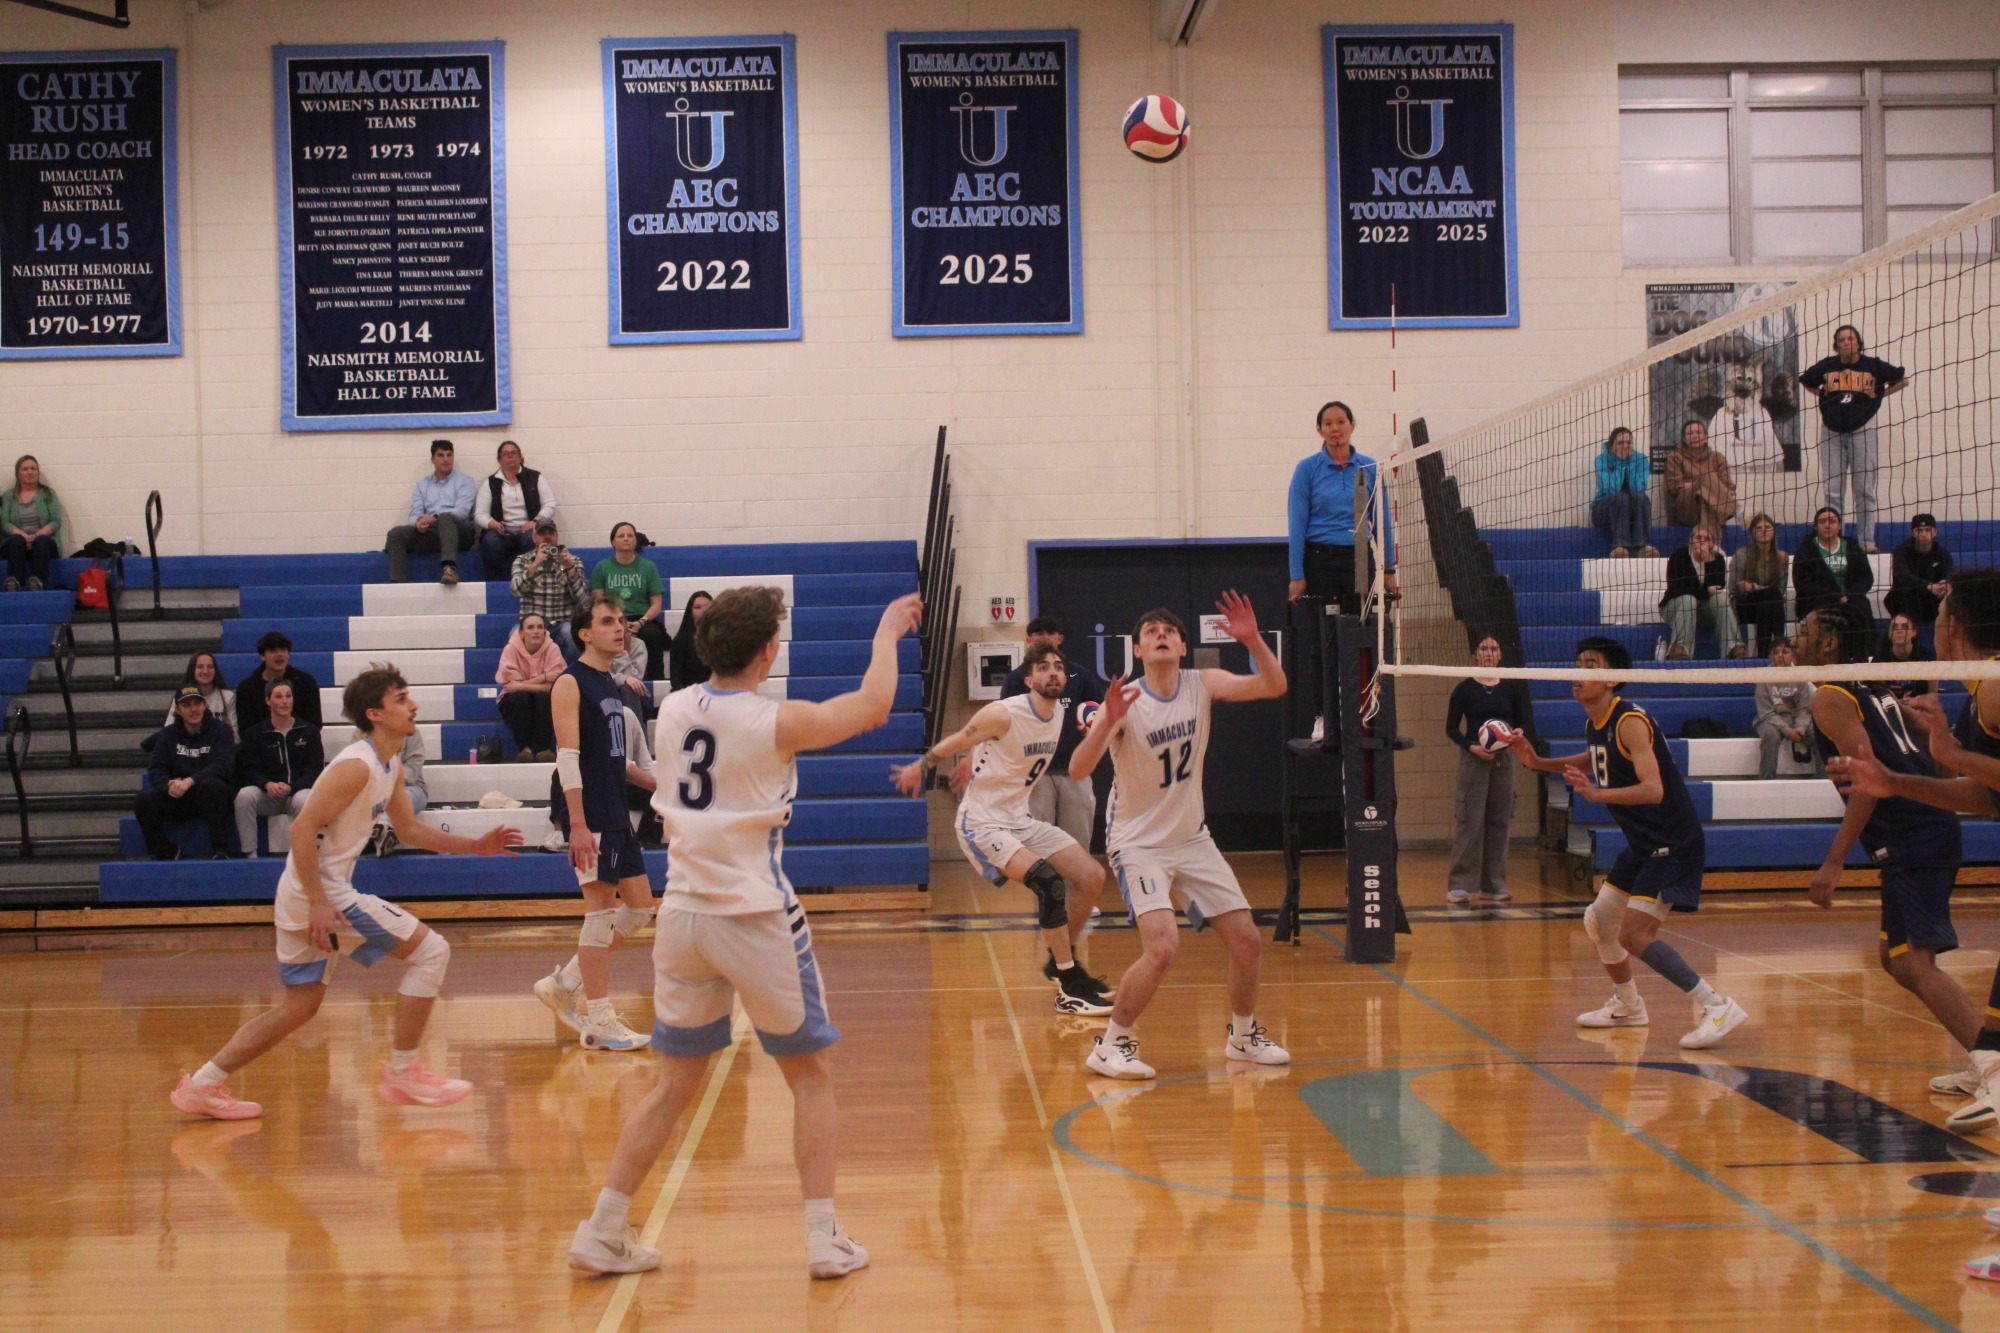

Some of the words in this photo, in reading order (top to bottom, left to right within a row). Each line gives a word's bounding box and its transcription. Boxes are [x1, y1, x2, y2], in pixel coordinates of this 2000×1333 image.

[907, 52, 1060, 73] IMMACULATA
[1343, 45, 1495, 66] IMMACULATA
[622, 56, 776, 79] IMMACULATA
[1346, 69, 1408, 81] WOMEN'S
[1411, 67, 1493, 80] BASKETBALL
[17, 70, 141, 101] CATHY
[297, 67, 482, 94] IMMACULATA
[624, 81, 687, 93] WOMEN'S
[690, 79, 774, 93] BASKETBALL
[910, 75, 971, 88] WOMEN'S
[975, 74, 1058, 87] BASKETBALL
[301, 99, 374, 112] WOMEN'S
[379, 96, 480, 111] BASKETBALL
[31, 104, 128, 133] RUSH
[365, 116, 416, 129] TEAMS
[9, 143, 70, 161] HEAD
[76, 141, 153, 159] COACH
[303, 145, 348, 160] 1972
[369, 144, 415, 159] 1973
[436, 142, 481, 158] 1974
[40, 169, 124, 183] IMMACULATA
[1372, 166, 1473, 196] NCAA
[52, 184, 113, 198] WOMEN'S
[666, 178, 738, 208] AEC
[950, 172, 1021, 202] AEC
[42, 199, 123, 213] BASKETBALL
[911, 205, 1061, 228] CHAMPIONS
[1349, 200, 1496, 221] TOURNAMENT
[627, 211, 779, 235] CHAMPIONS
[1359, 226, 1409, 243] 2022
[1437, 224, 1488, 241] 2025
[34, 222, 130, 251] 149-15
[12, 264, 79, 277] NAISMITH
[82, 262, 154, 276] MEMORIAL
[657, 260, 751, 291] 2022
[939, 254, 1033, 285] 2025
[42, 278, 125, 292] BASKETBALL
[36, 294, 72, 307] HALL
[75, 293, 93, 306] OF
[96, 292, 132, 305] FAME
[26, 315, 142, 336] 1970-1977
[360, 321, 432, 344] 2014
[308, 353, 389, 366] NAISMITH
[394, 350, 485, 364] MEMORIAL
[344, 369, 449, 383] BASKETBALL
[337, 388, 381, 400] HALL
[385, 387, 408, 399] OF
[412, 386, 456, 398] FAME
[608, 574, 642, 588] LUCKY
[1869, 694, 1920, 754] 17
[609, 715, 625, 757] 10
[678, 724, 717, 812] 3
[1025, 758, 1046, 787] 9
[1159, 740, 1192, 789] 12
[1589, 744, 1609, 788] 13
